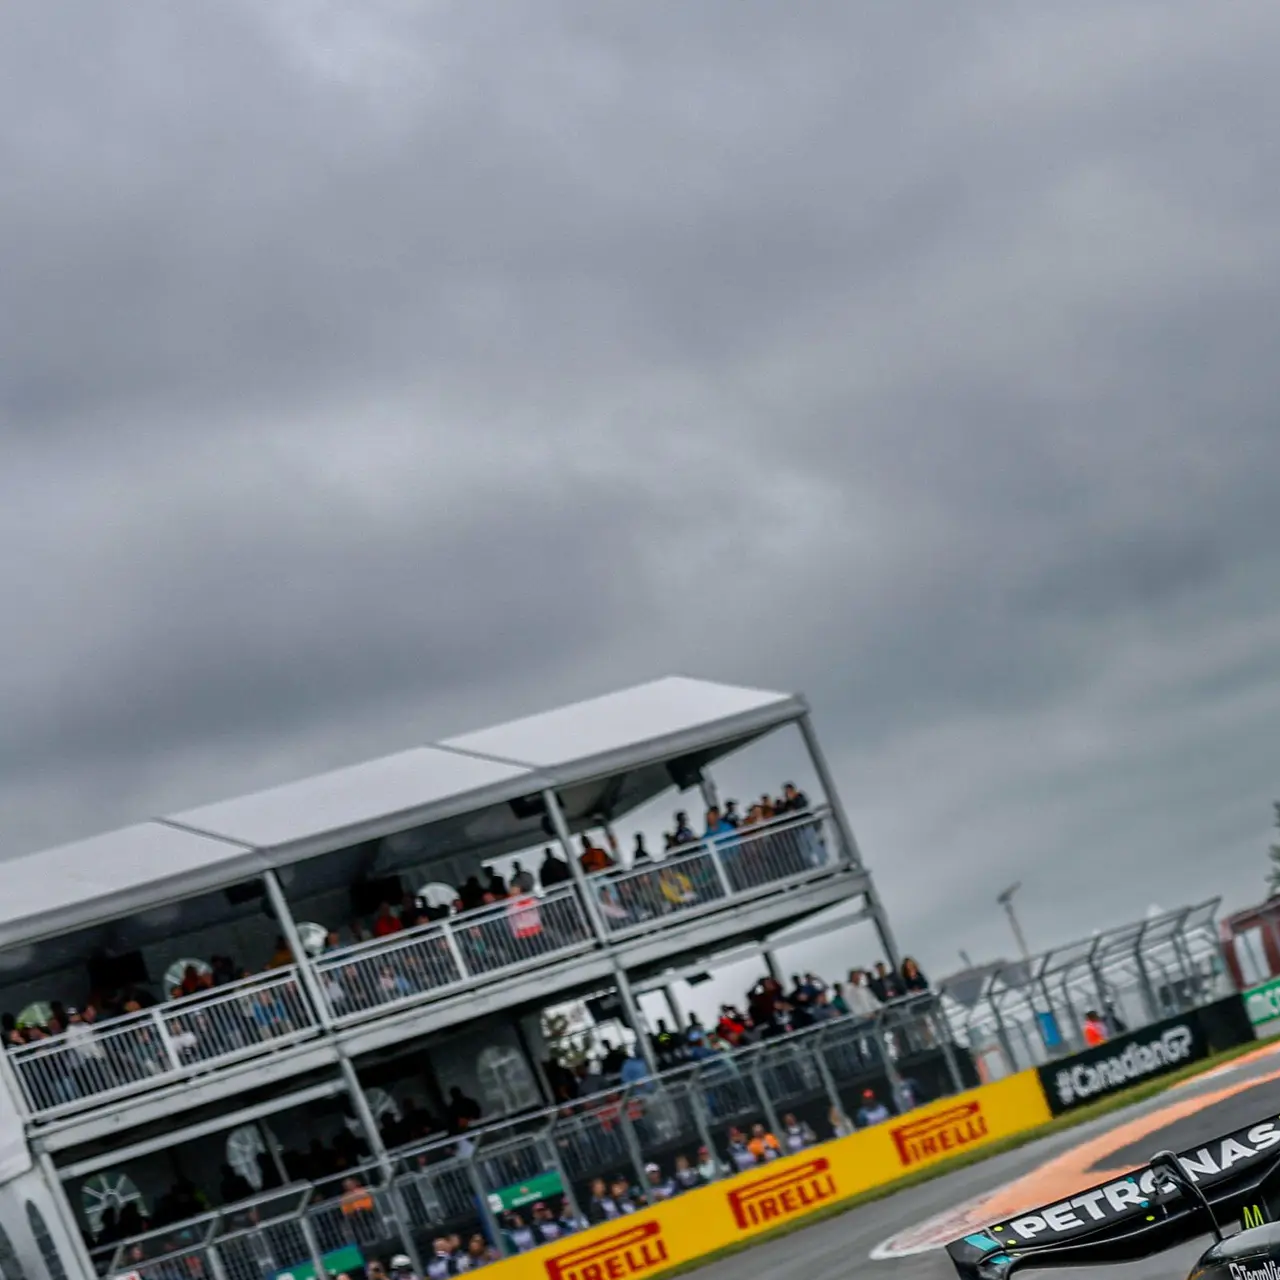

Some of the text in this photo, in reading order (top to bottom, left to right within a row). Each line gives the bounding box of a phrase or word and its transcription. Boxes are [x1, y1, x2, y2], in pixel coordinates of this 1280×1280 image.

[1055, 1024, 1193, 1105] #CanadianGP
[891, 1101, 988, 1166] PIRELLI
[728, 1157, 837, 1229] PIRELLI
